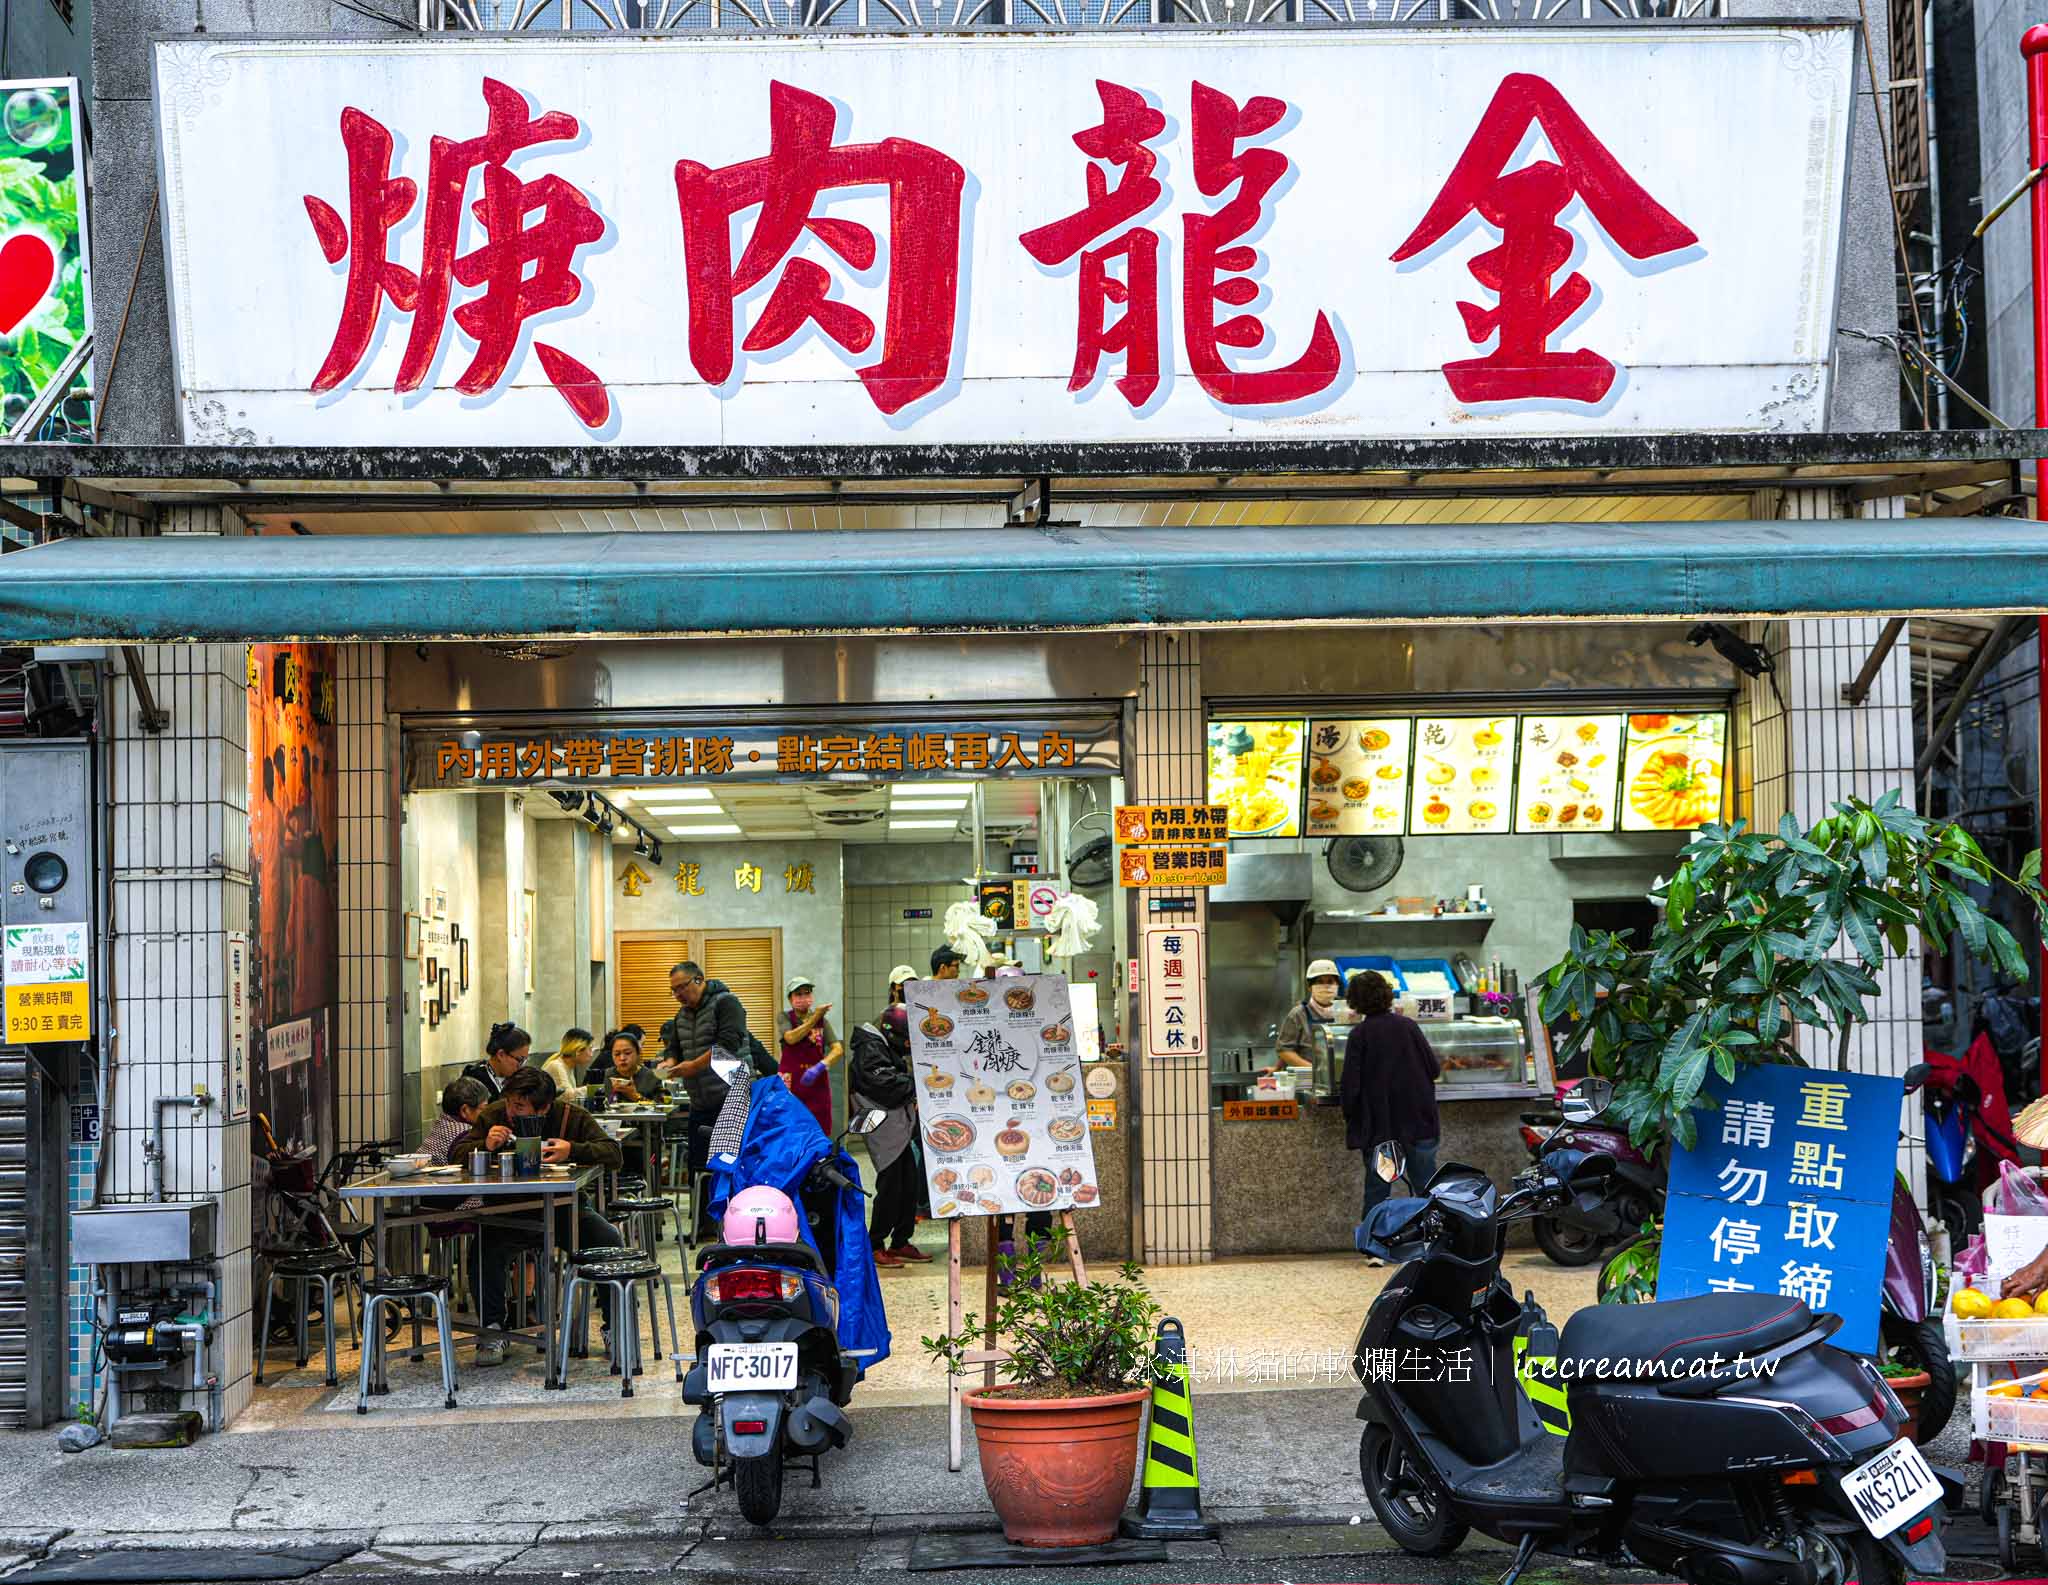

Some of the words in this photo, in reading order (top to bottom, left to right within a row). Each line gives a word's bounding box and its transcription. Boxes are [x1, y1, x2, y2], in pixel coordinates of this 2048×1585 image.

[1316, 725, 1340, 748] 湯
[1424, 723, 1446, 746] 乾
[1529, 723, 1549, 747] 菜
[1152, 850, 1224, 870] 營業時間
[33, 933, 54, 945] 飲料
[19, 991, 73, 1007] 營業時間
[1162, 935, 1184, 1048] 每週二公休
[12, 1016, 38, 1032] 9:30
[41, 1015, 54, 1031] 至
[57, 1014, 83, 1031] 賣完
[1778, 1081, 1852, 1310] 重點取締
